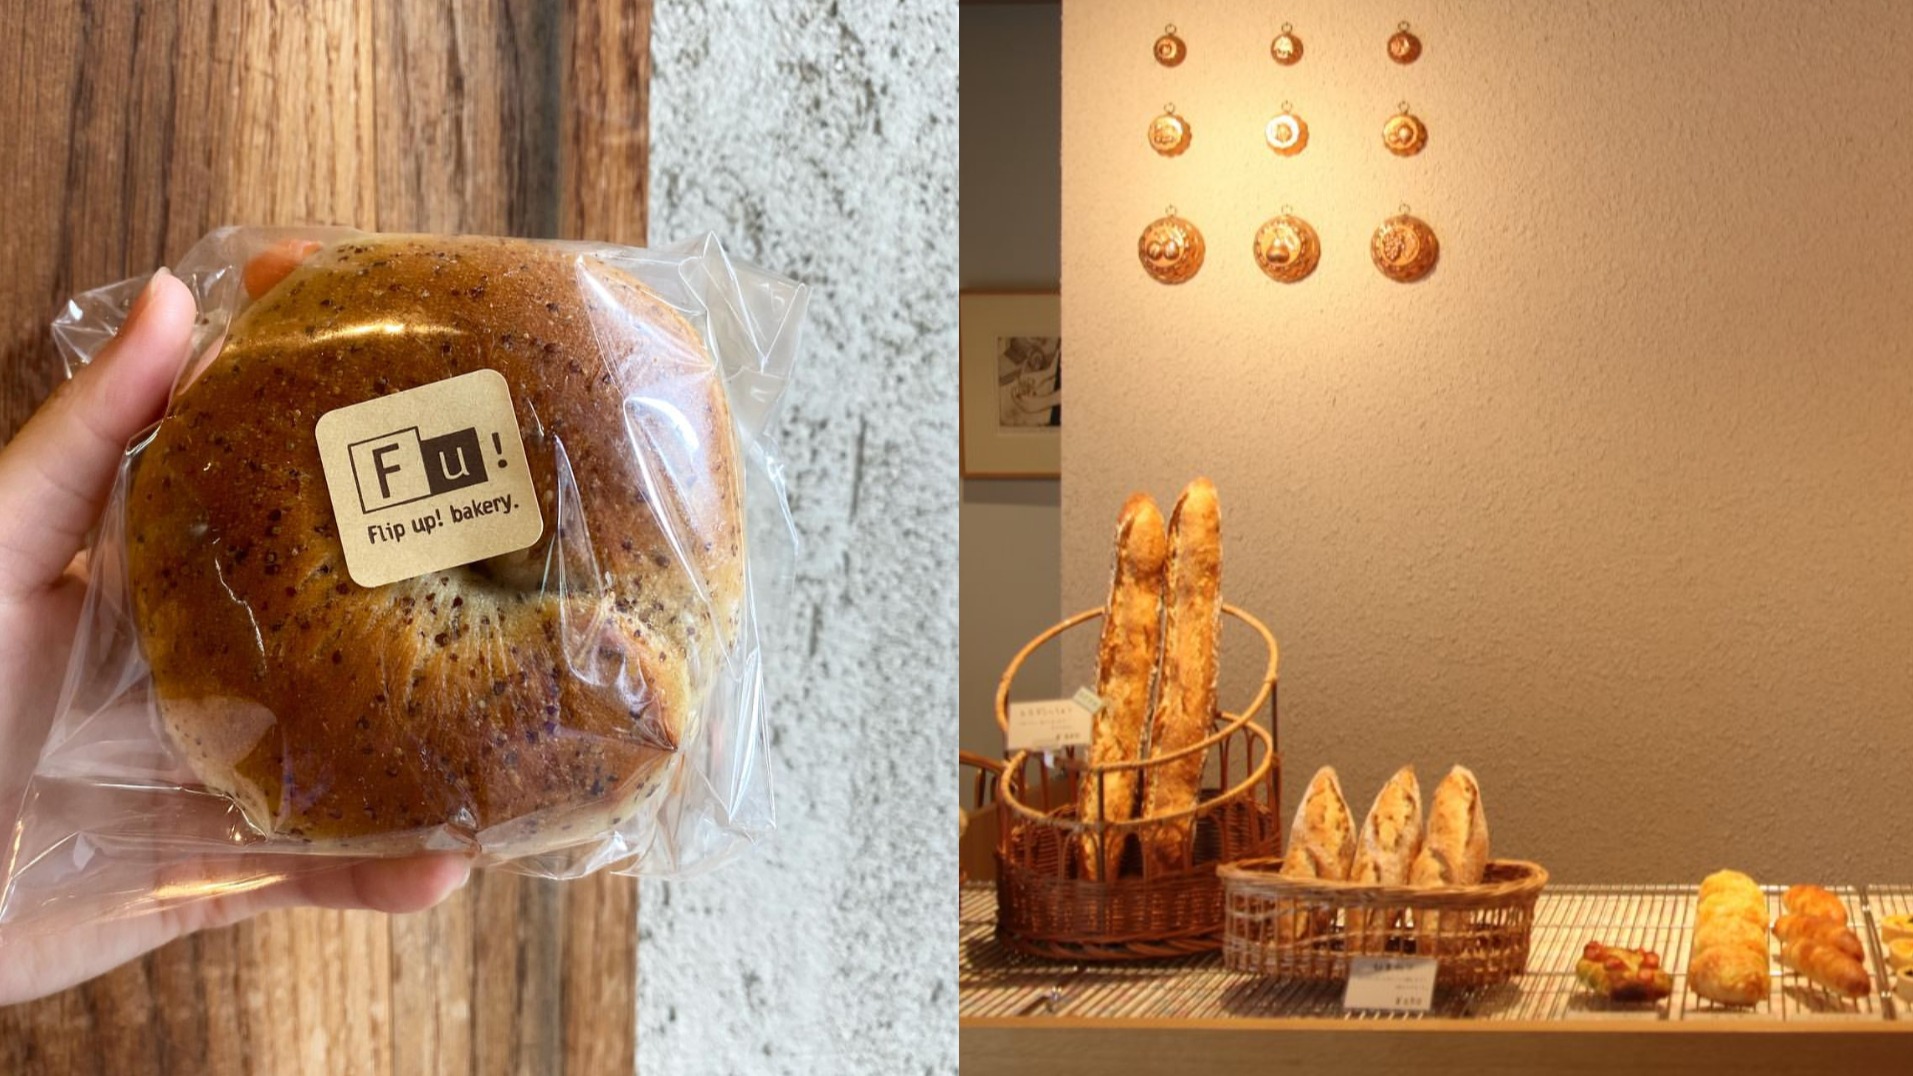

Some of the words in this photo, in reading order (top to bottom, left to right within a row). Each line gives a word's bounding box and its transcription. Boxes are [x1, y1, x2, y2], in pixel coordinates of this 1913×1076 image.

[372, 432, 508, 499] Fu!
[368, 522, 405, 544] Flip
[412, 509, 443, 534] up!
[450, 494, 519, 523] bakery.
